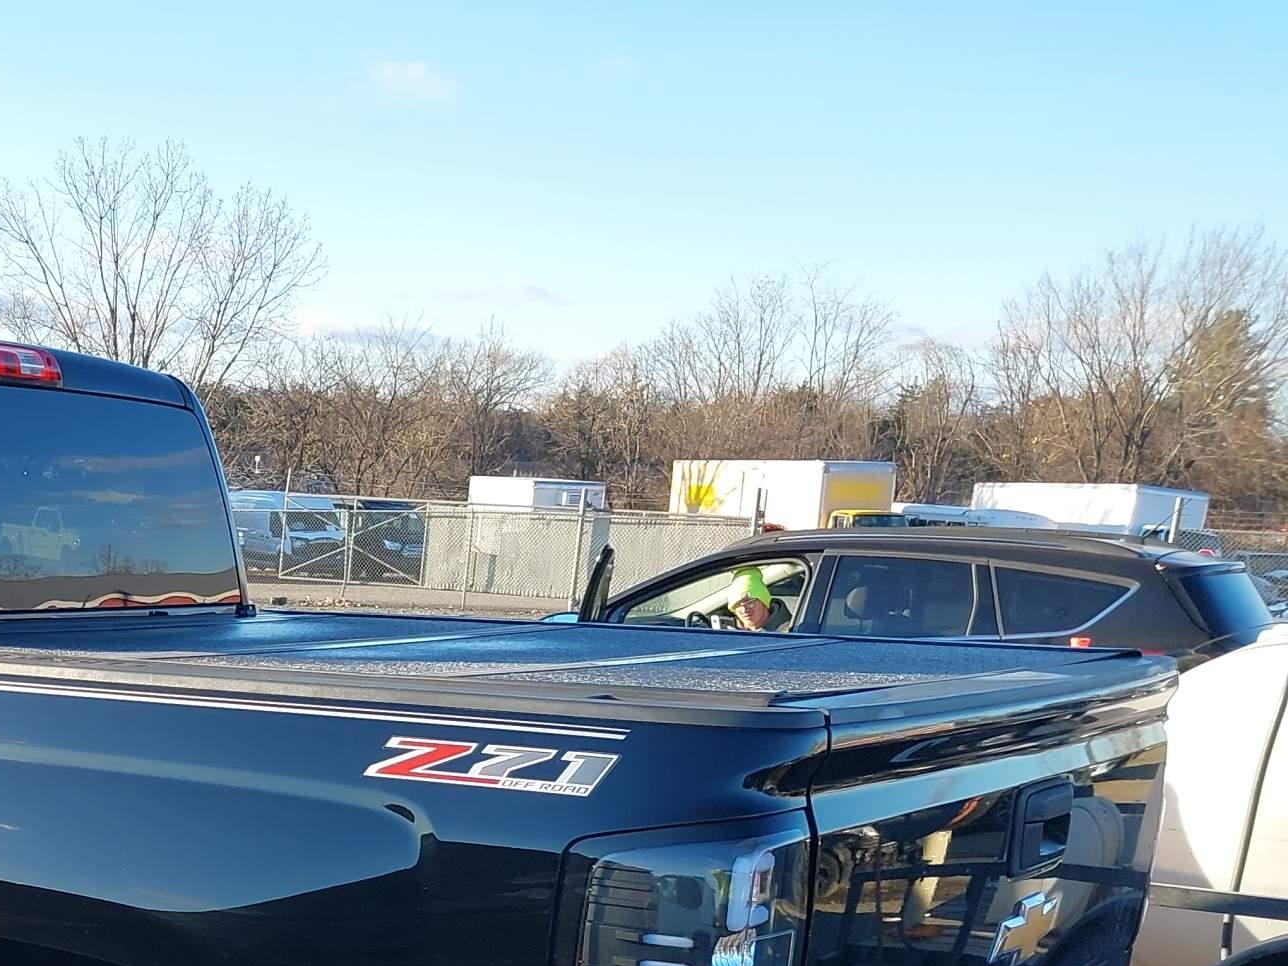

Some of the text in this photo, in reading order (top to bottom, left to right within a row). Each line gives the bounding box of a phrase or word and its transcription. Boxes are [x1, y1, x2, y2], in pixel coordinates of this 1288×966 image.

[362, 735, 621, 797] Z71
[502, 778, 590, 794] OFF ROAD
